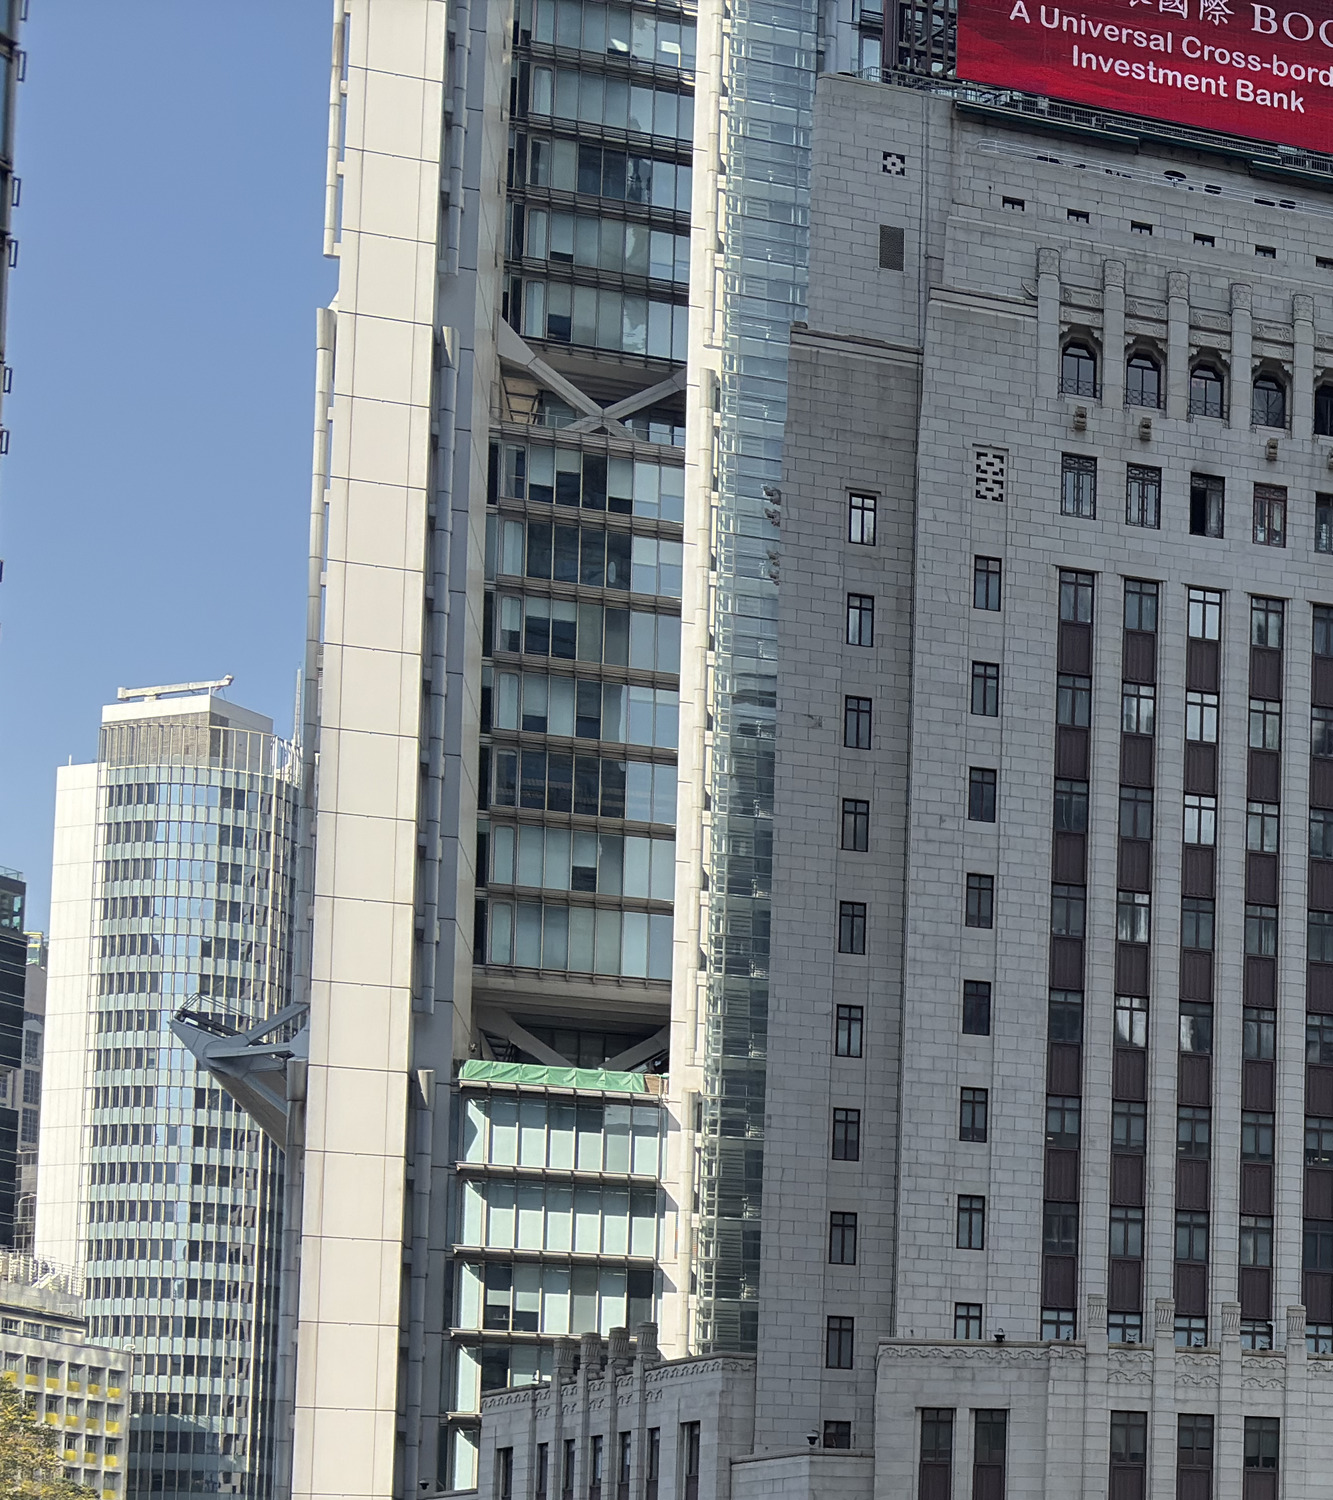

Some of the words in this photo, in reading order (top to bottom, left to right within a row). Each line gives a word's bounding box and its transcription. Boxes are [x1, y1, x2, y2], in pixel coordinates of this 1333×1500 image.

[1009, 0, 1031, 23] A
[1040, 5, 1173, 54] Universal
[1129, 0, 1235, 26] 國際
[1072, 45, 1228, 98] Investment
[1236, 79, 1306, 114] Bank
